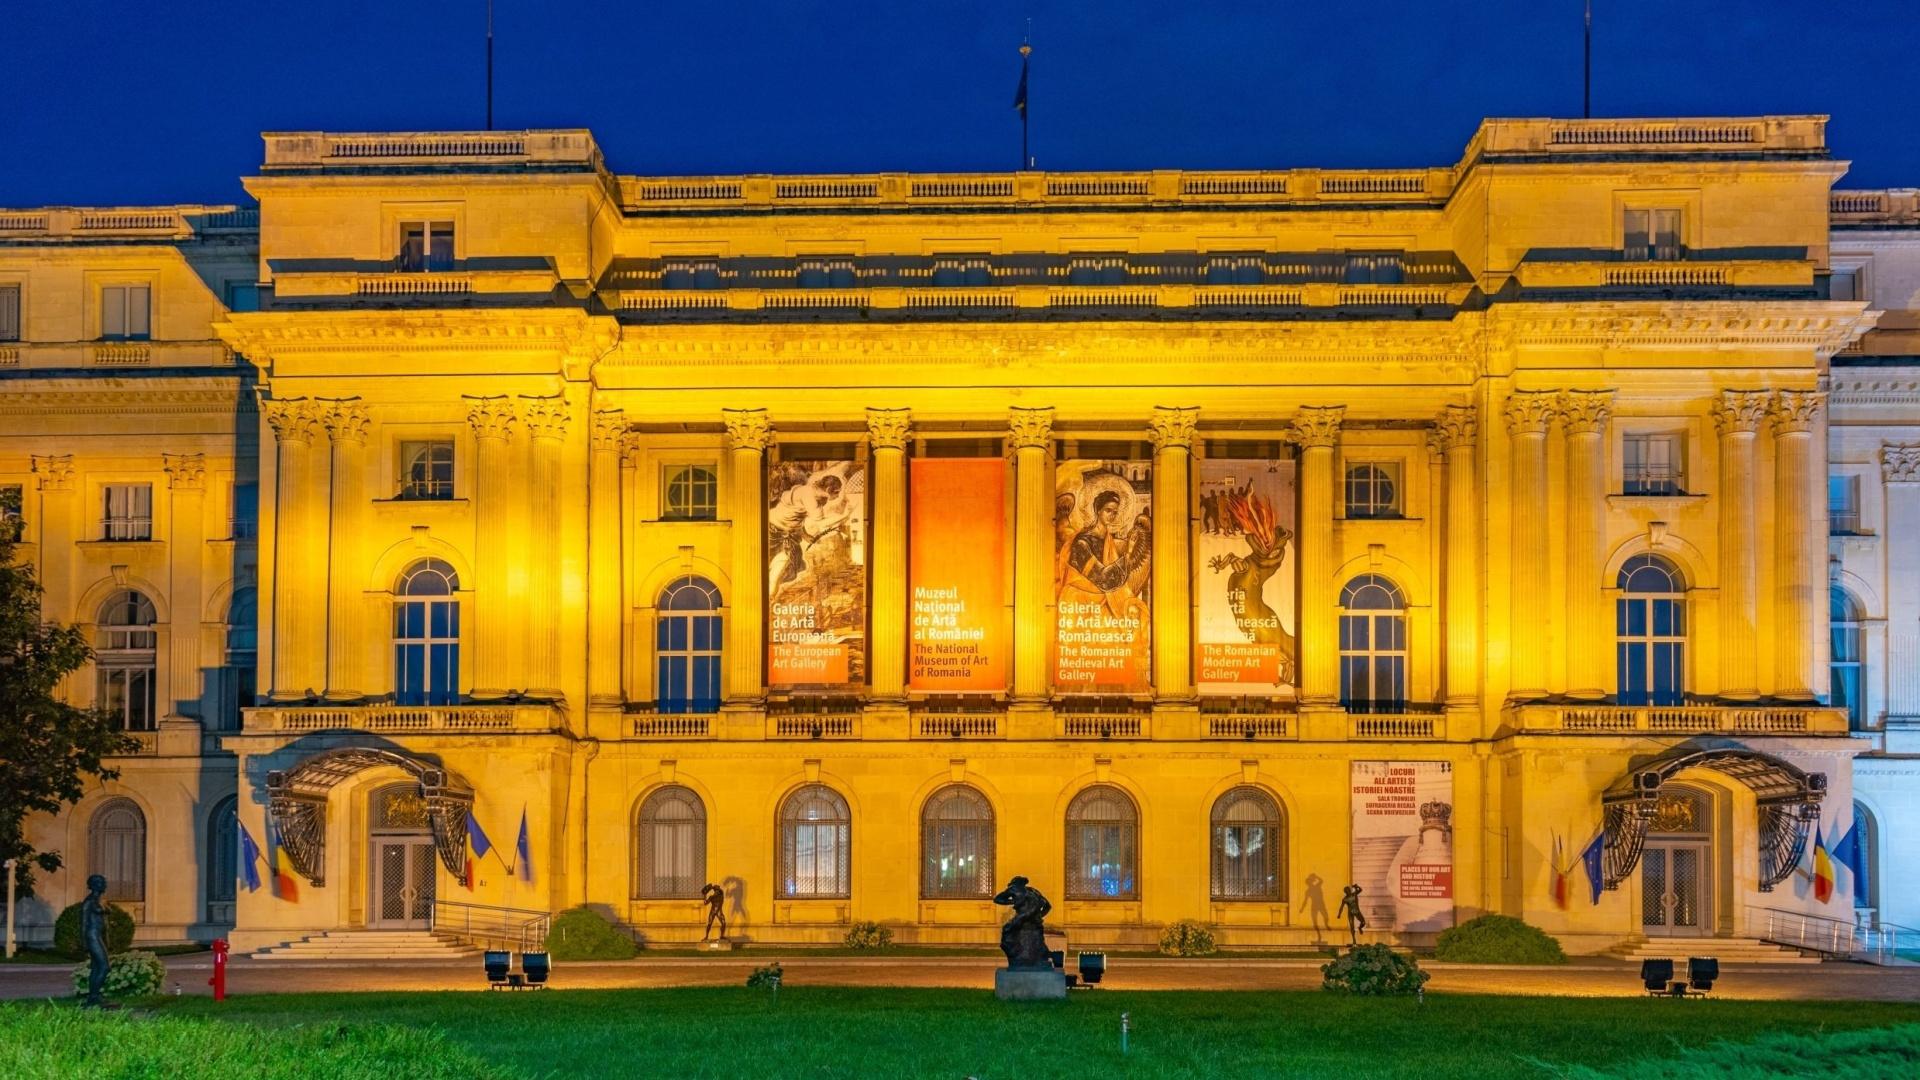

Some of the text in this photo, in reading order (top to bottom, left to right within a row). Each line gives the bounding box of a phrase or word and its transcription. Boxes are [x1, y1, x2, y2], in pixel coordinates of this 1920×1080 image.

[915, 586, 957, 599] Muzeul
[773, 602, 814, 615] Galeria
[1060, 601, 1100, 614] Galeria
[773, 615, 814, 628] de Artă
[915, 613, 956, 626] de Artă
[1059, 615, 1139, 628] de Artă Veche
[773, 629, 834, 643] Europeană
[914, 627, 984, 640] al României
[1059, 629, 1133, 642] Românească
[774, 646, 841, 658] The European
[915, 643, 978, 653] The National
[1060, 646, 1131, 656] The Romanian
[1204, 645, 1276, 656] The Romanian
[773, 657, 826, 670] Art Gallery
[915, 655, 988, 665] Museum of Art
[1060, 658, 1124, 668] Medieval Art
[1203, 656, 1260, 667] Modern Art
[915, 667, 971, 677] of Romania
[1060, 669, 1095, 682] Gallery
[1203, 668, 1239, 682] Gallery
[1390, 768, 1415, 776] LOCURI
[1374, 777, 1386, 785] ALE
[1387, 777, 1407, 785] ARTEI
[1353, 786, 1415, 794] ISTORIEI NOASTRE
